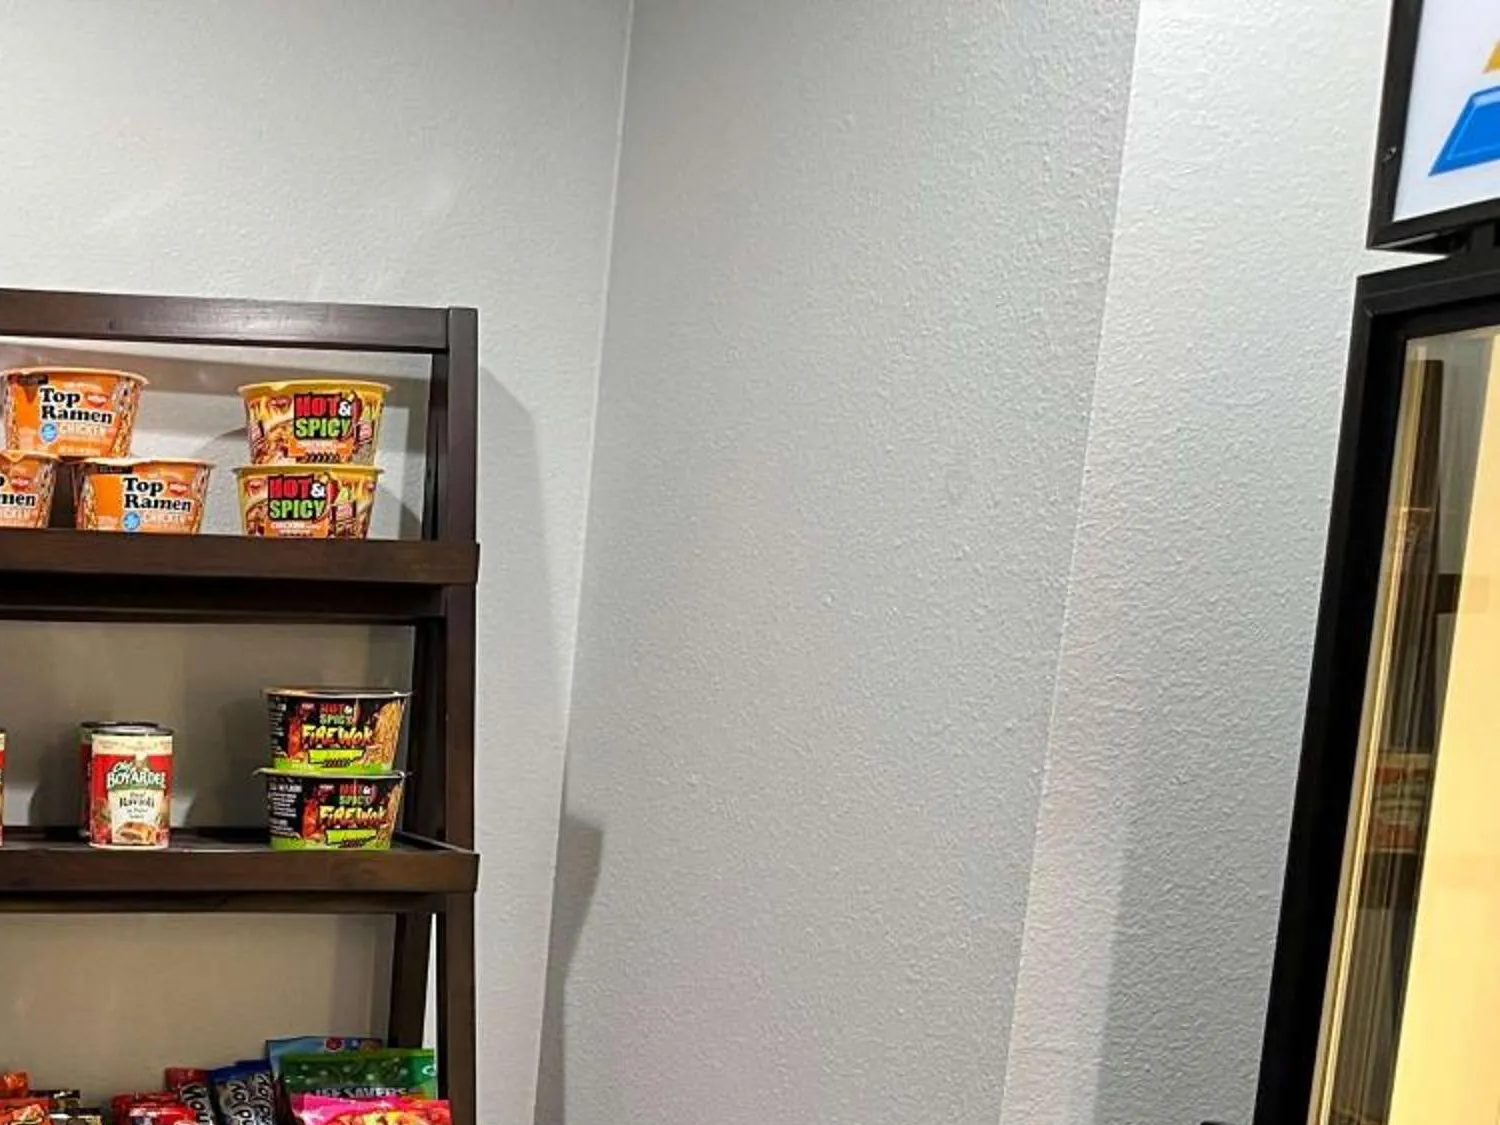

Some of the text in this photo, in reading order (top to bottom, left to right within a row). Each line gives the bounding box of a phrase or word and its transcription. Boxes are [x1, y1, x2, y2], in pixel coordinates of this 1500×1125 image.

[40, 387, 80, 407] Top
[42, 405, 113, 424] Ramen
[295, 418, 350, 439] SPICY
[123, 477, 164, 496] Top
[124, 494, 191, 512] Ramen
[269, 499, 324, 519] SPICY
